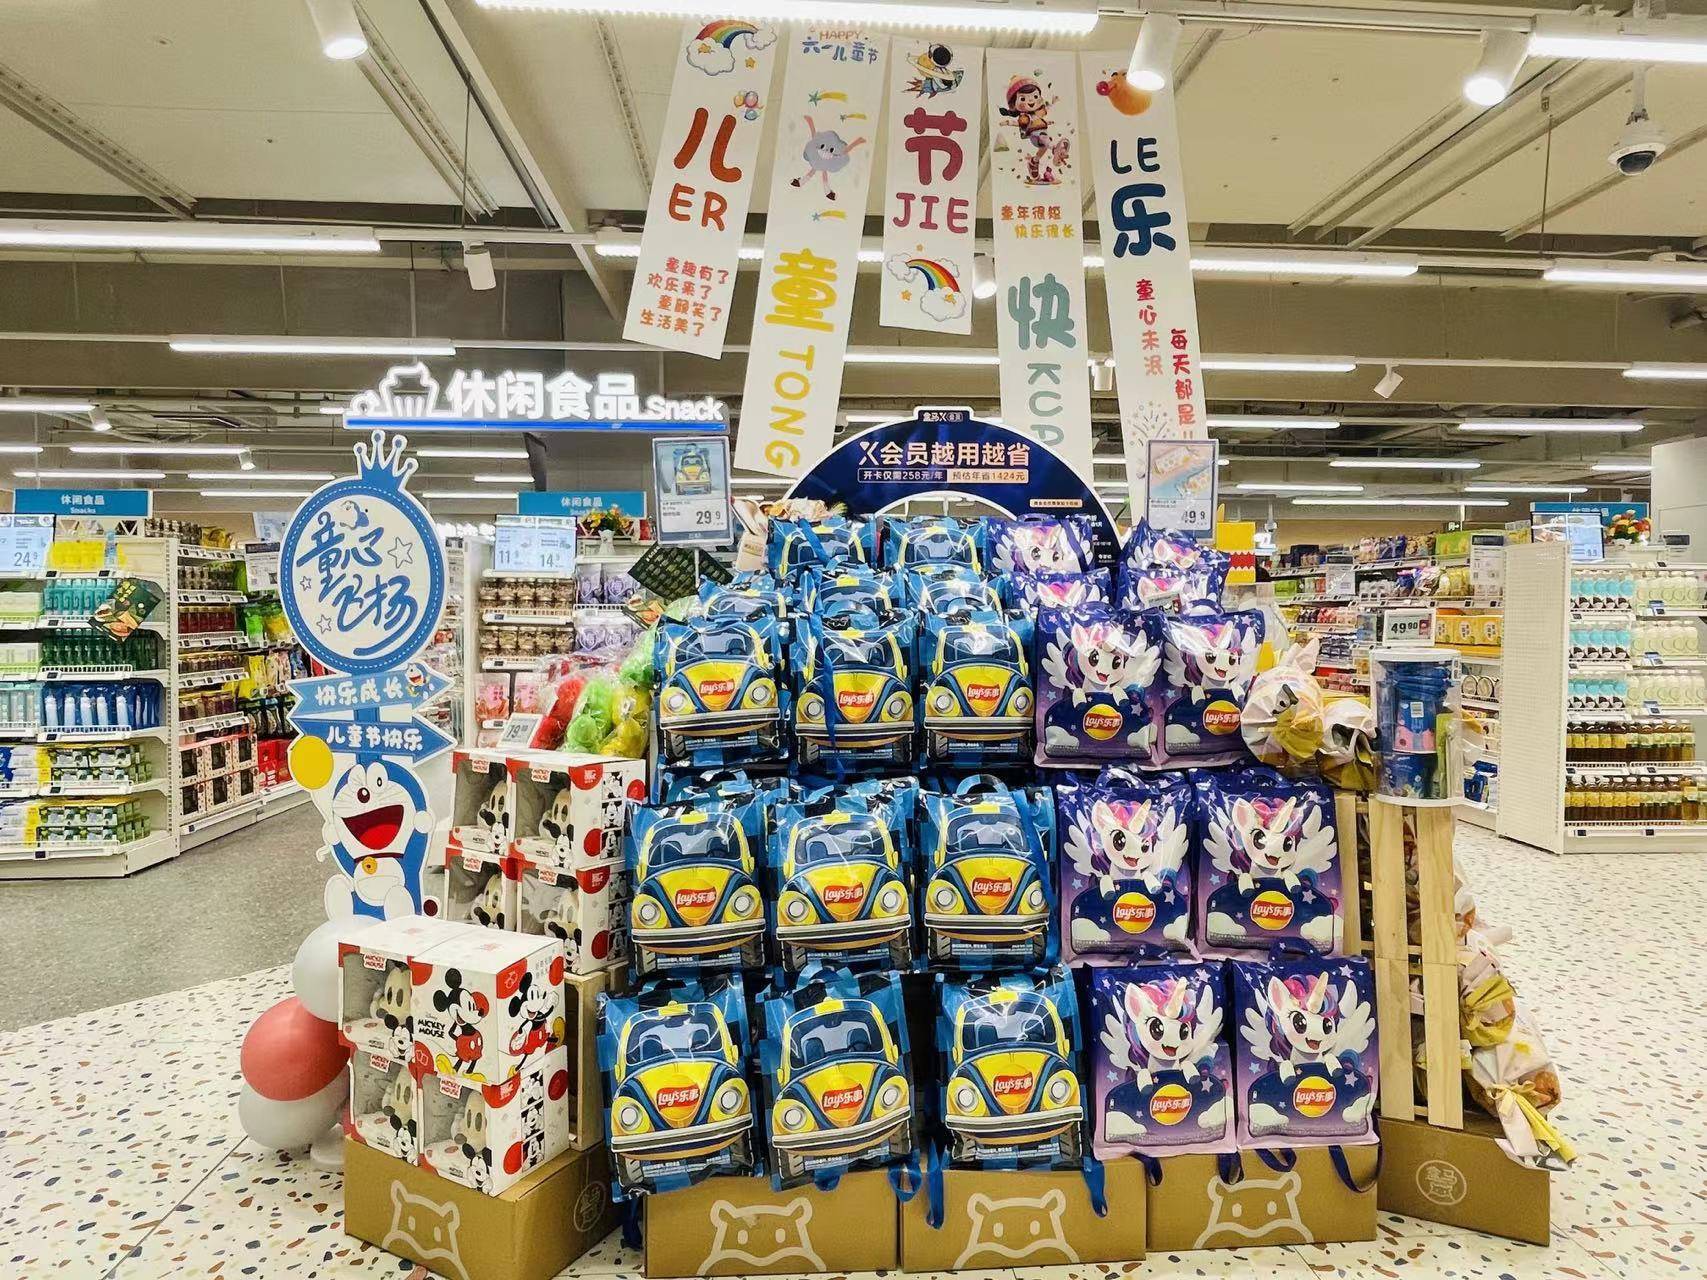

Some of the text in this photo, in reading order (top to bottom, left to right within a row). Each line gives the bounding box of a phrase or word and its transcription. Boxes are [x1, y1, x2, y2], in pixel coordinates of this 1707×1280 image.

[819, 30, 862, 41] HAPPY
[802, 36, 878, 64] 六一儿童节
[674, 107, 742, 183] 儿
[904, 107, 967, 185] 节
[1111, 137, 1160, 174] LE
[668, 183, 727, 231] ER
[892, 192, 970, 234] JIE
[1001, 205, 1061, 221] 童年很短
[1015, 223, 1074, 239] 快乐很长
[1111, 183, 1176, 258] 乐
[665, 256, 729, 285] 童趣有了
[647, 272, 712, 300] 欢乐来了
[765, 248, 837, 332] 童
[640, 308, 704, 337] 生活美了
[1008, 273, 1077, 351] 快
[1136, 278, 1163, 376] 童心未泯
[445, 369, 725, 421] 休闲食品 Snack
[1170, 328, 1196, 439] 每天都是
[765, 345, 815, 469] TONG
[859, 441, 1030, 467] X会员越用越省
[863, 471, 1026, 482] 开卡仅需258元/年 预估年省1424元
[61, 494, 104, 505] 休闲食品
[561, 496, 603, 507] 休闲食品
[296, 511, 384, 602] 童心
[315, 679, 402, 706] 快乐成长
[326, 724, 423, 751] 儿童节快乐
[677, 887, 716, 906] Lay's乐事
[824, 884, 863, 901] Lay's乐事
[974, 878, 1011, 896] Lay's乐事
[1116, 906, 1154, 920] Lay's乐事
[1253, 903, 1293, 917] Lay's乐事
[418, 1019, 446, 1031] MICKEY
[419, 1027, 445, 1039] MOUSE
[657, 1088, 699, 1106] Lay's乐事
[824, 1089, 863, 1109] Lay's乐事
[995, 1077, 1032, 1095] Lay's乐事
[1296, 1090, 1335, 1104] Lay's乐事
[1153, 1099, 1191, 1112] Lay's乐事
